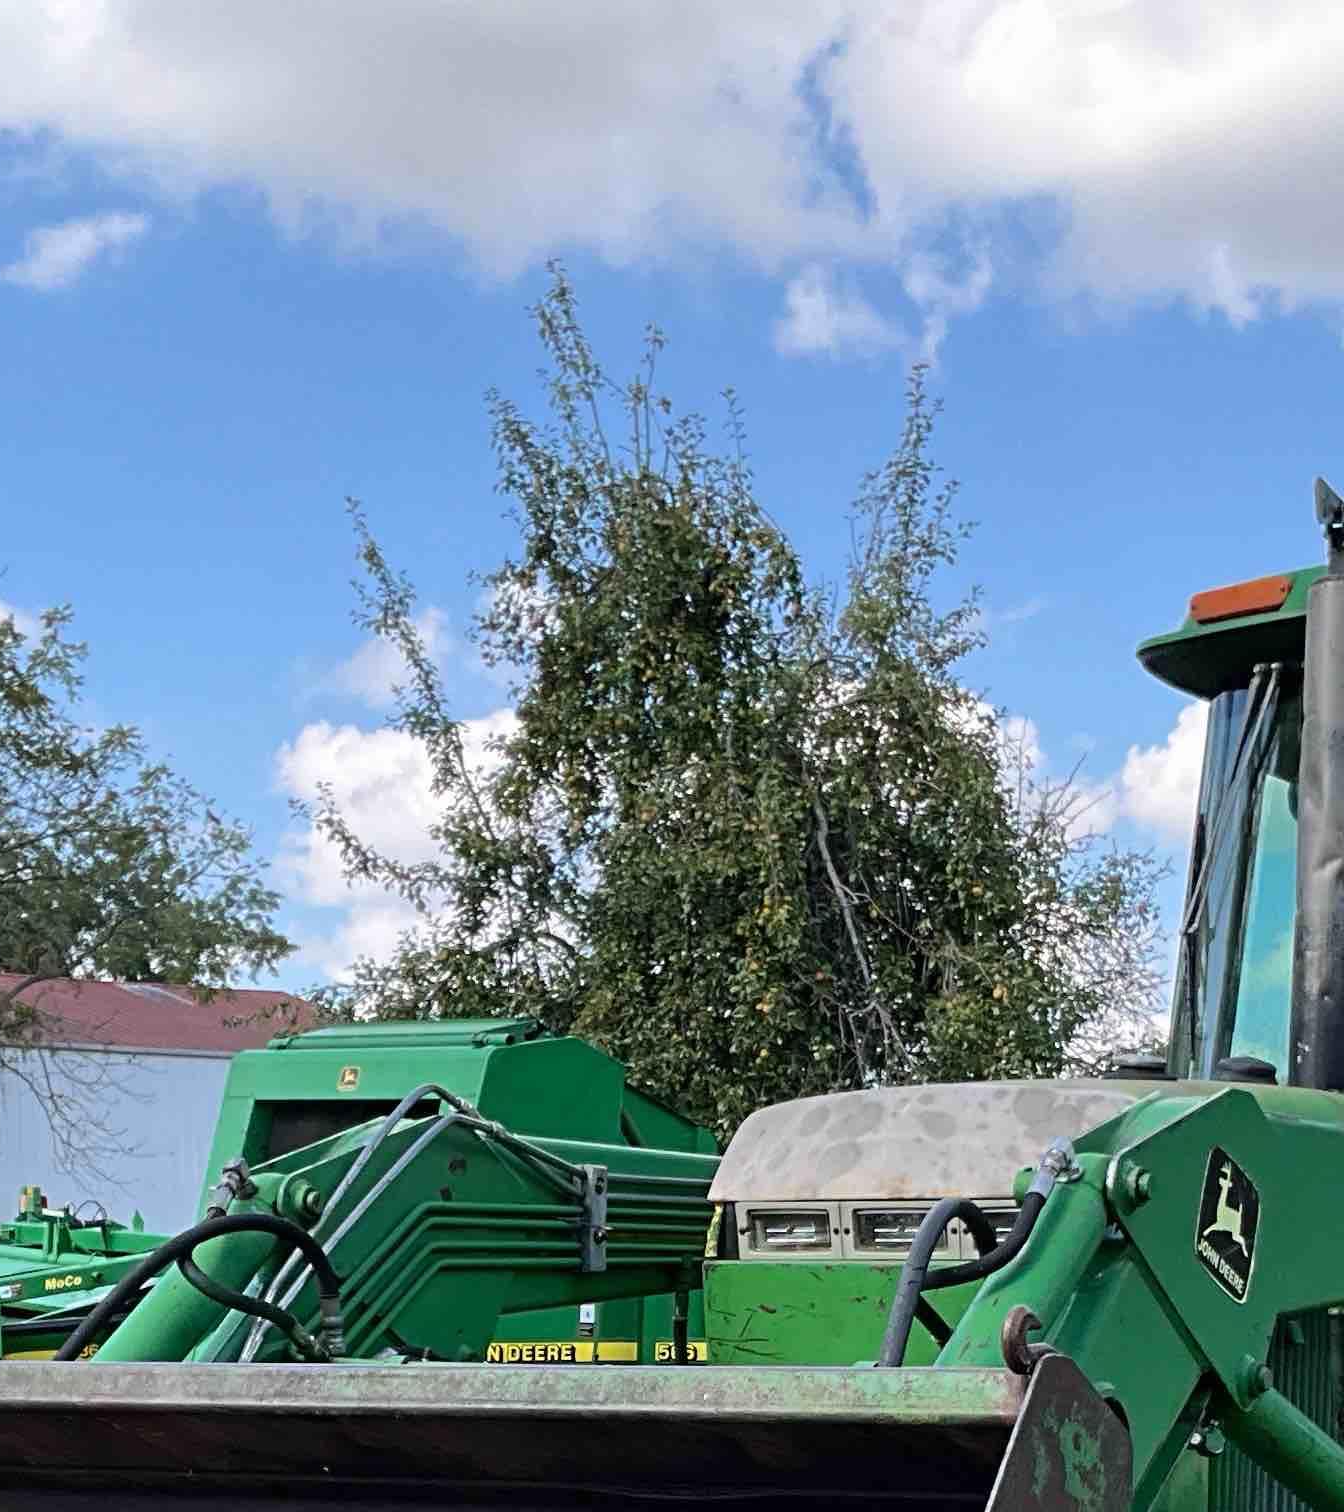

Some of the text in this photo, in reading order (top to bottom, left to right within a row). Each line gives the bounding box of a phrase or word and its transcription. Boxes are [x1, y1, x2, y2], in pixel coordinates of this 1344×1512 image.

[1198, 1238, 1245, 1294] JOHN DEERE
[45, 1275, 81, 1290] MoCo
[507, 1343, 574, 1361] DEERE
